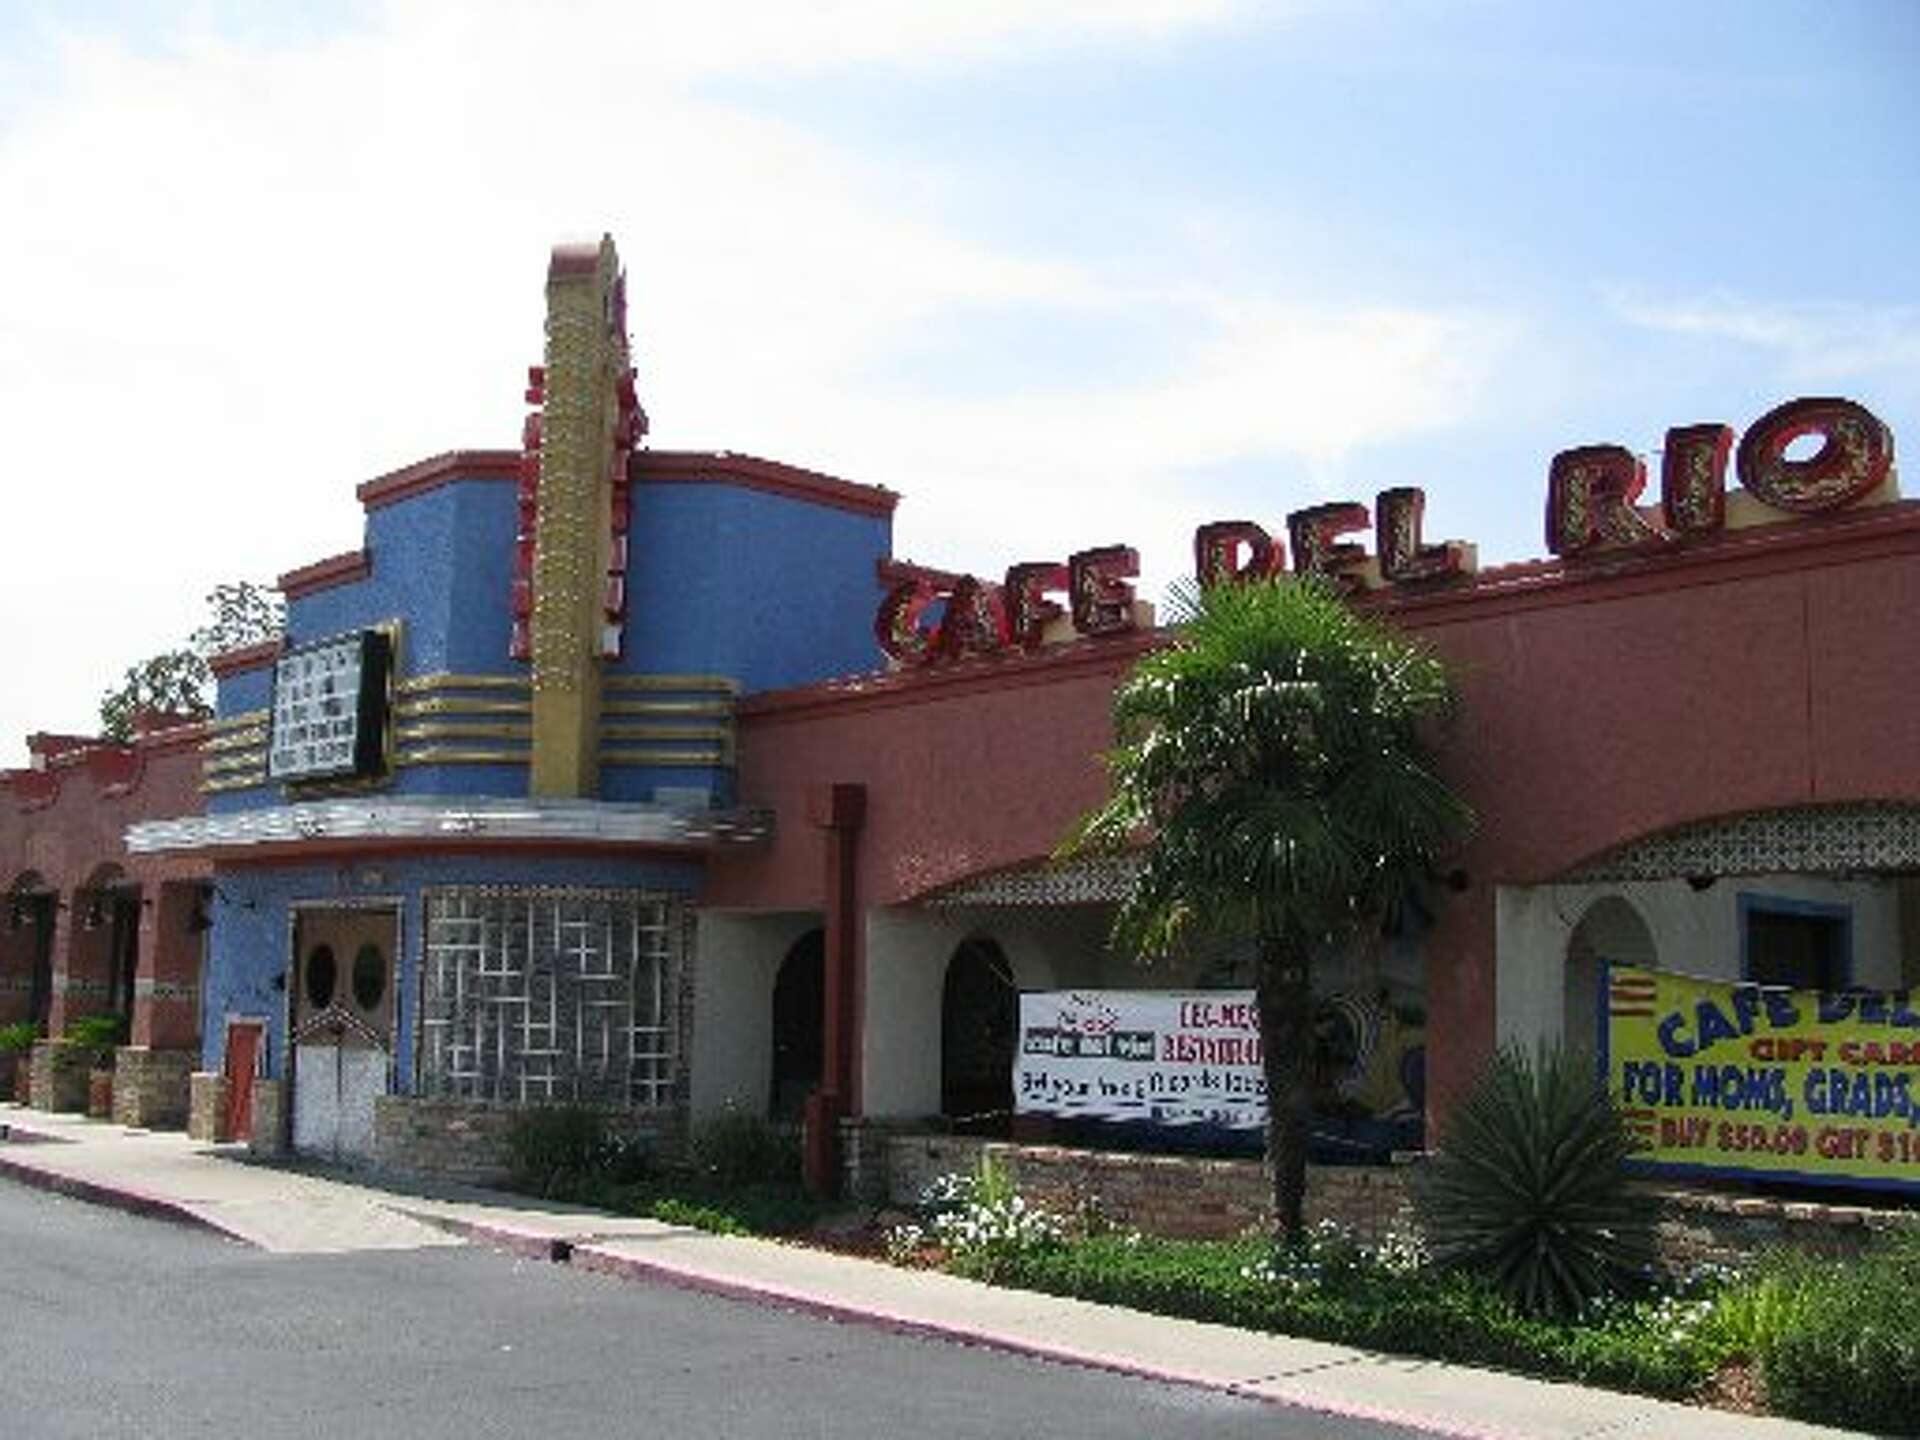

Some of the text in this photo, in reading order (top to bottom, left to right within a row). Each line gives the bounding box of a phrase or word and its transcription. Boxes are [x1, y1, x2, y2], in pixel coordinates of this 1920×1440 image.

[875, 396, 1895, 663] CAFE DEL RIO
[1657, 986, 1799, 1058] CAFE
[1748, 1036, 1827, 1062] GIFT
[1623, 1061, 1685, 1107] FOR
[1692, 1065, 1793, 1121] MOMS,
[1660, 1116, 1711, 1149] BUY
[1815, 1125, 1870, 1160] GET
